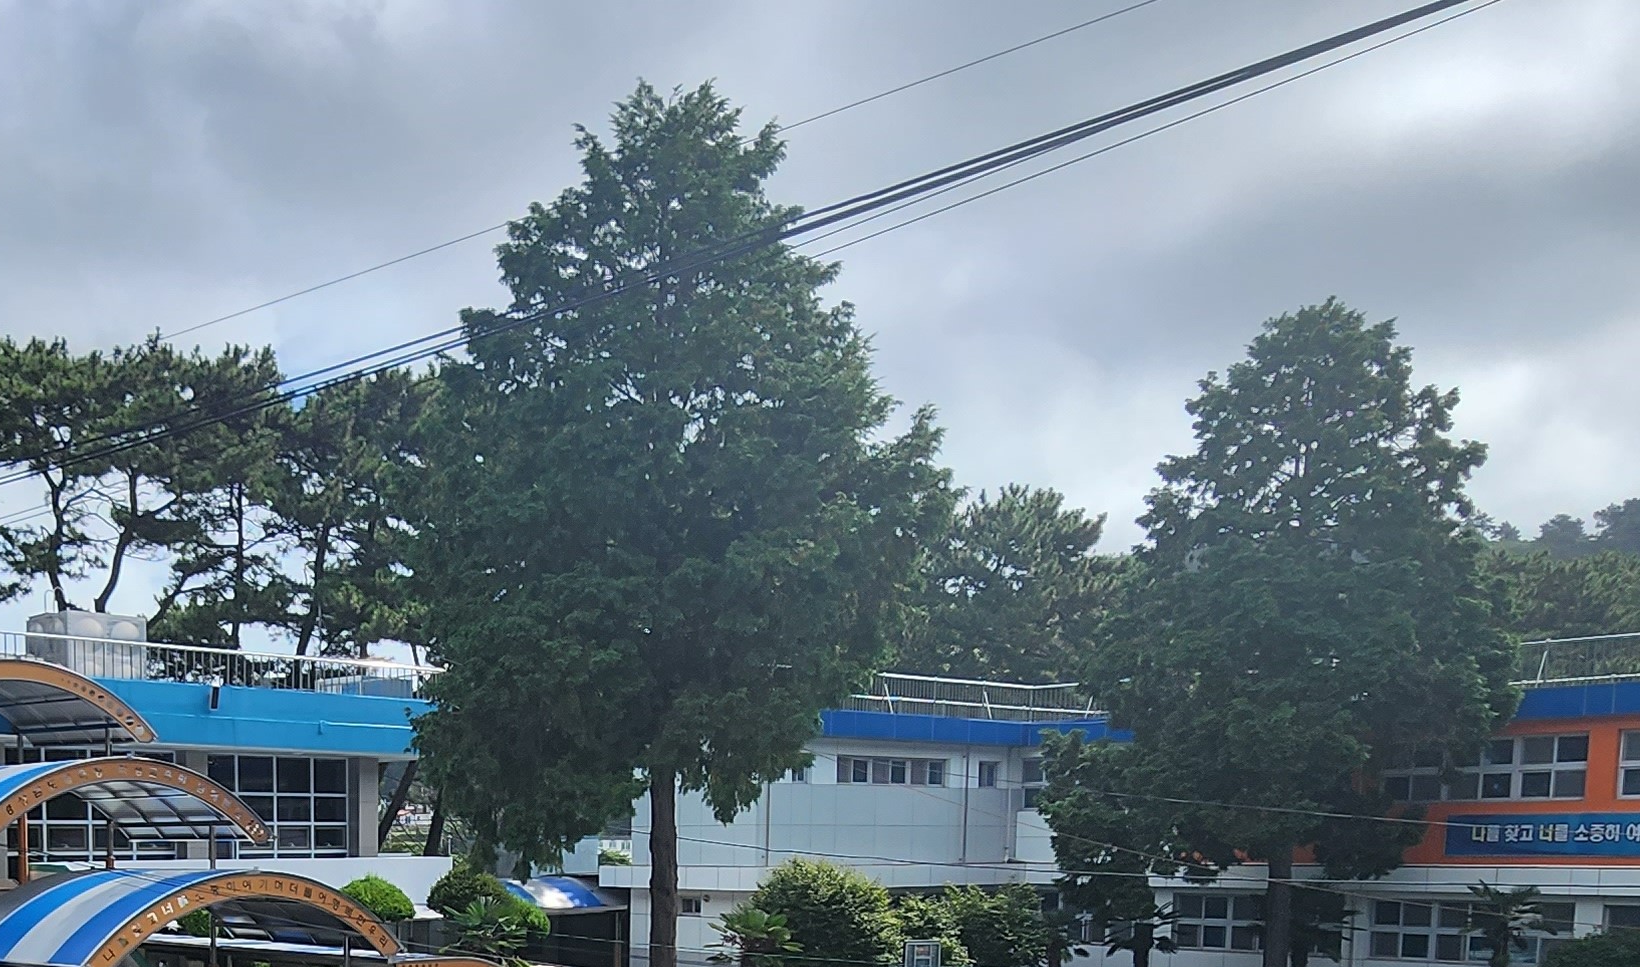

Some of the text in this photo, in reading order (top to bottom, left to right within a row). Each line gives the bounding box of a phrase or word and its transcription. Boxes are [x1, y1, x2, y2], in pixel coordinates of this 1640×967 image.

[1471, 823, 1500, 842] 나를
[1504, 824, 1534, 842] 찾고
[1539, 823, 1568, 842] 너를
[1573, 823, 1621, 843] 소중히
